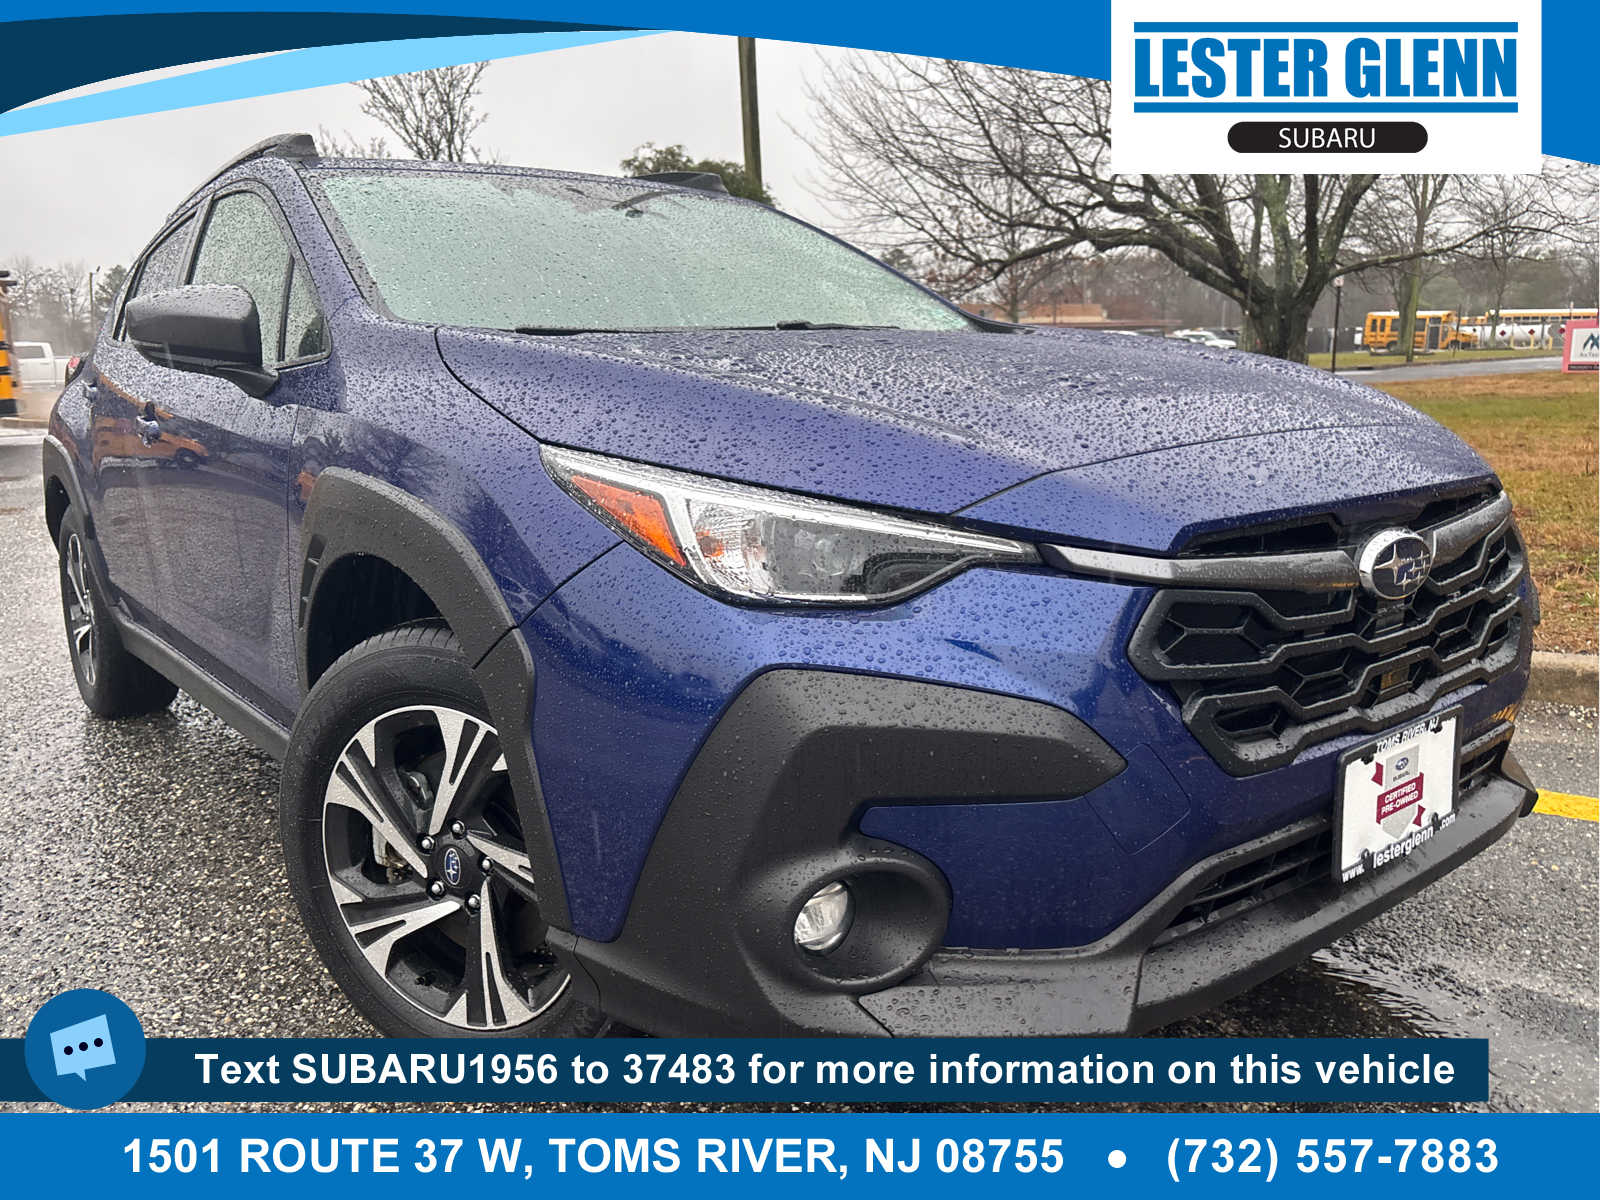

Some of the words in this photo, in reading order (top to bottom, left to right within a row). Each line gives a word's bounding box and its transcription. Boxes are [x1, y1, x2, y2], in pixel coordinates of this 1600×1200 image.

[1376, 733, 1401, 753] TOMS
[1428, 716, 1440, 732] NJ
[1381, 790, 1419, 815] PRE-OWNED
[1384, 782, 1416, 803] CERTIFIED
[1373, 827, 1434, 869] lesterglenn
